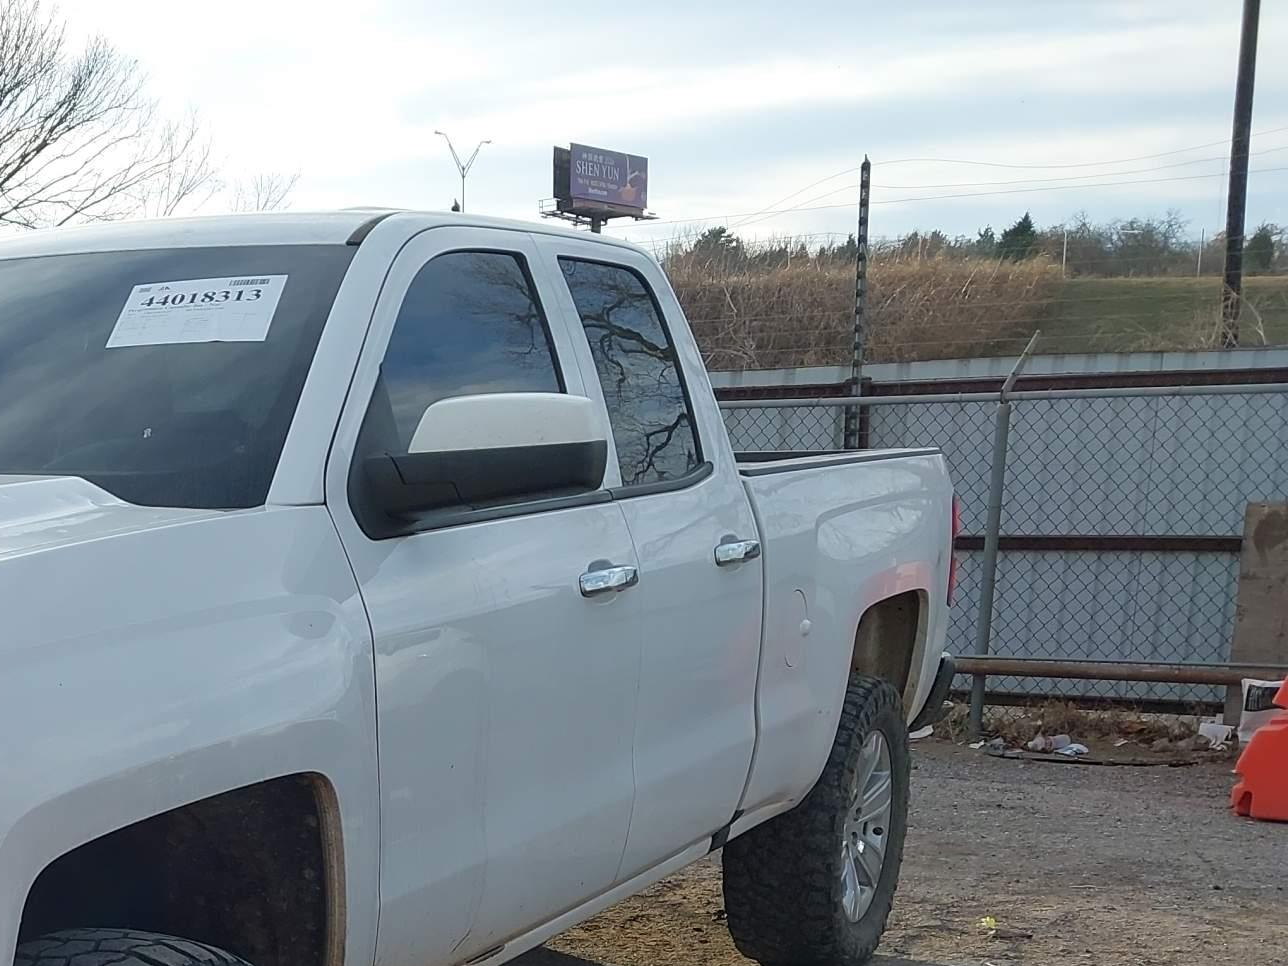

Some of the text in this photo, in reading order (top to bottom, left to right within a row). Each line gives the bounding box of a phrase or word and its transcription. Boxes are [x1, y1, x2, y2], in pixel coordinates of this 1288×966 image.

[576, 160, 619, 181] SHEN YUN
[140, 289, 262, 307] 44018313
